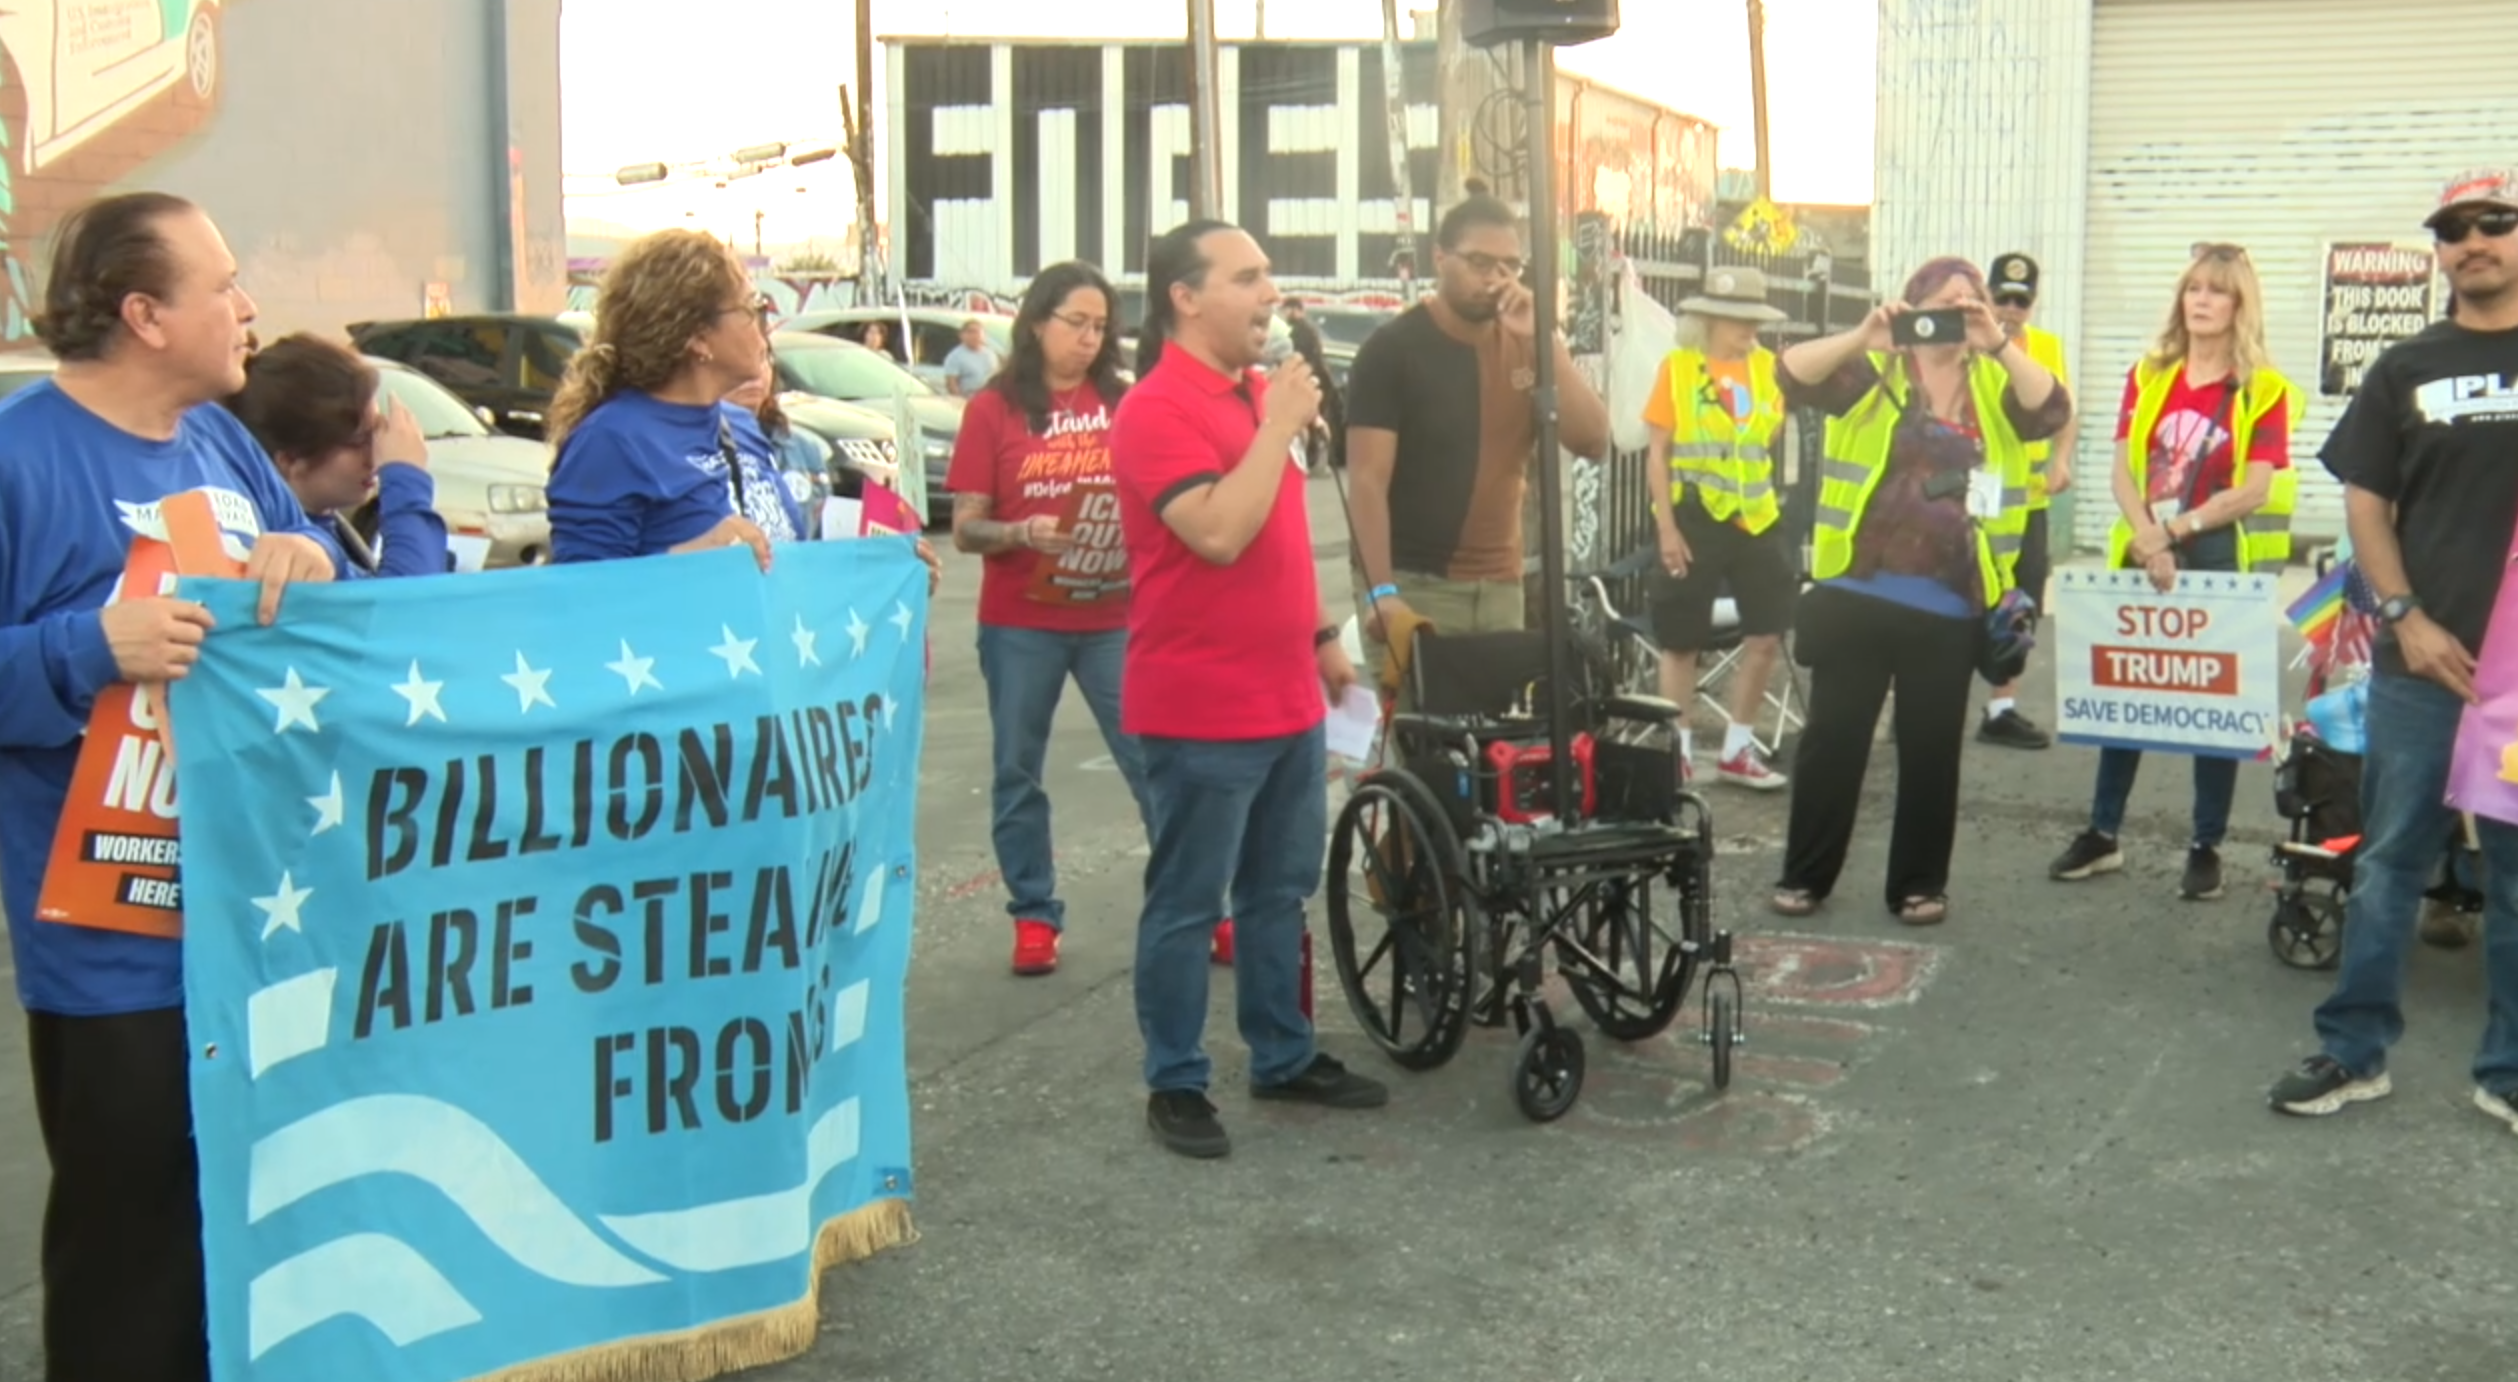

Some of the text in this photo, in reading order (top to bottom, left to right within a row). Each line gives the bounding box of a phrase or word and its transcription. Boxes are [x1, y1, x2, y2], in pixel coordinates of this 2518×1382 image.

[2333, 250, 2427, 273] WARNING
[2333, 286, 2371, 309] THIS
[2347, 312, 2424, 335] BLOCKED
[2116, 604, 2209, 639] STOP
[2106, 650, 2222, 688] TRUMP
[2063, 698, 2119, 724] SAVE
[366, 692, 882, 882] BILLIONAIRES
[128, 876, 181, 908] HERE
[353, 896, 538, 1040] ARE
